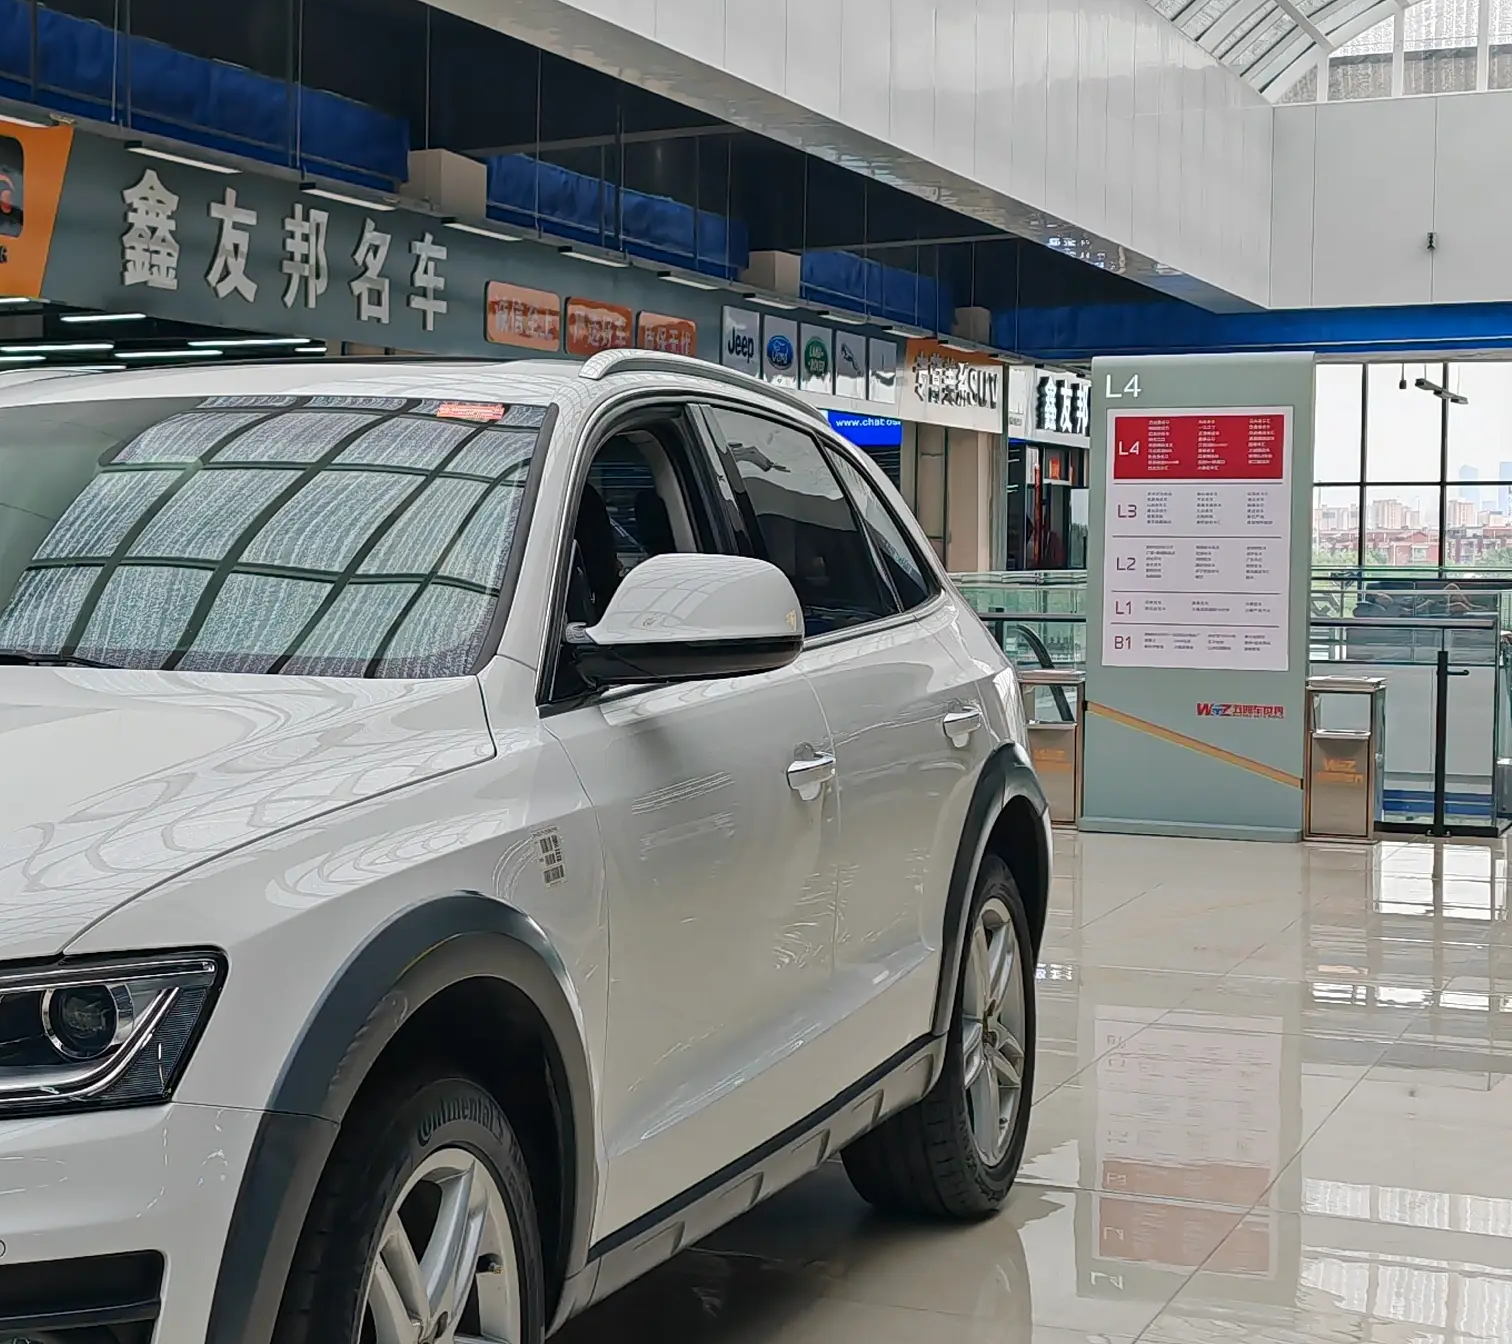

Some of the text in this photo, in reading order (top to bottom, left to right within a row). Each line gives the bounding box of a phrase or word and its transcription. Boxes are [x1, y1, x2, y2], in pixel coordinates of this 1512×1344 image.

[121, 167, 449, 332] 鑫友邦名车
[728, 327, 754, 364] Jeep
[1105, 373, 1142, 399] L4
[1118, 440, 1140, 456] L4
[1117, 504, 1137, 518] L3
[1116, 557, 1137, 571] L2
[1115, 600, 1132, 615] L1
[1114, 635, 1131, 650] B1
